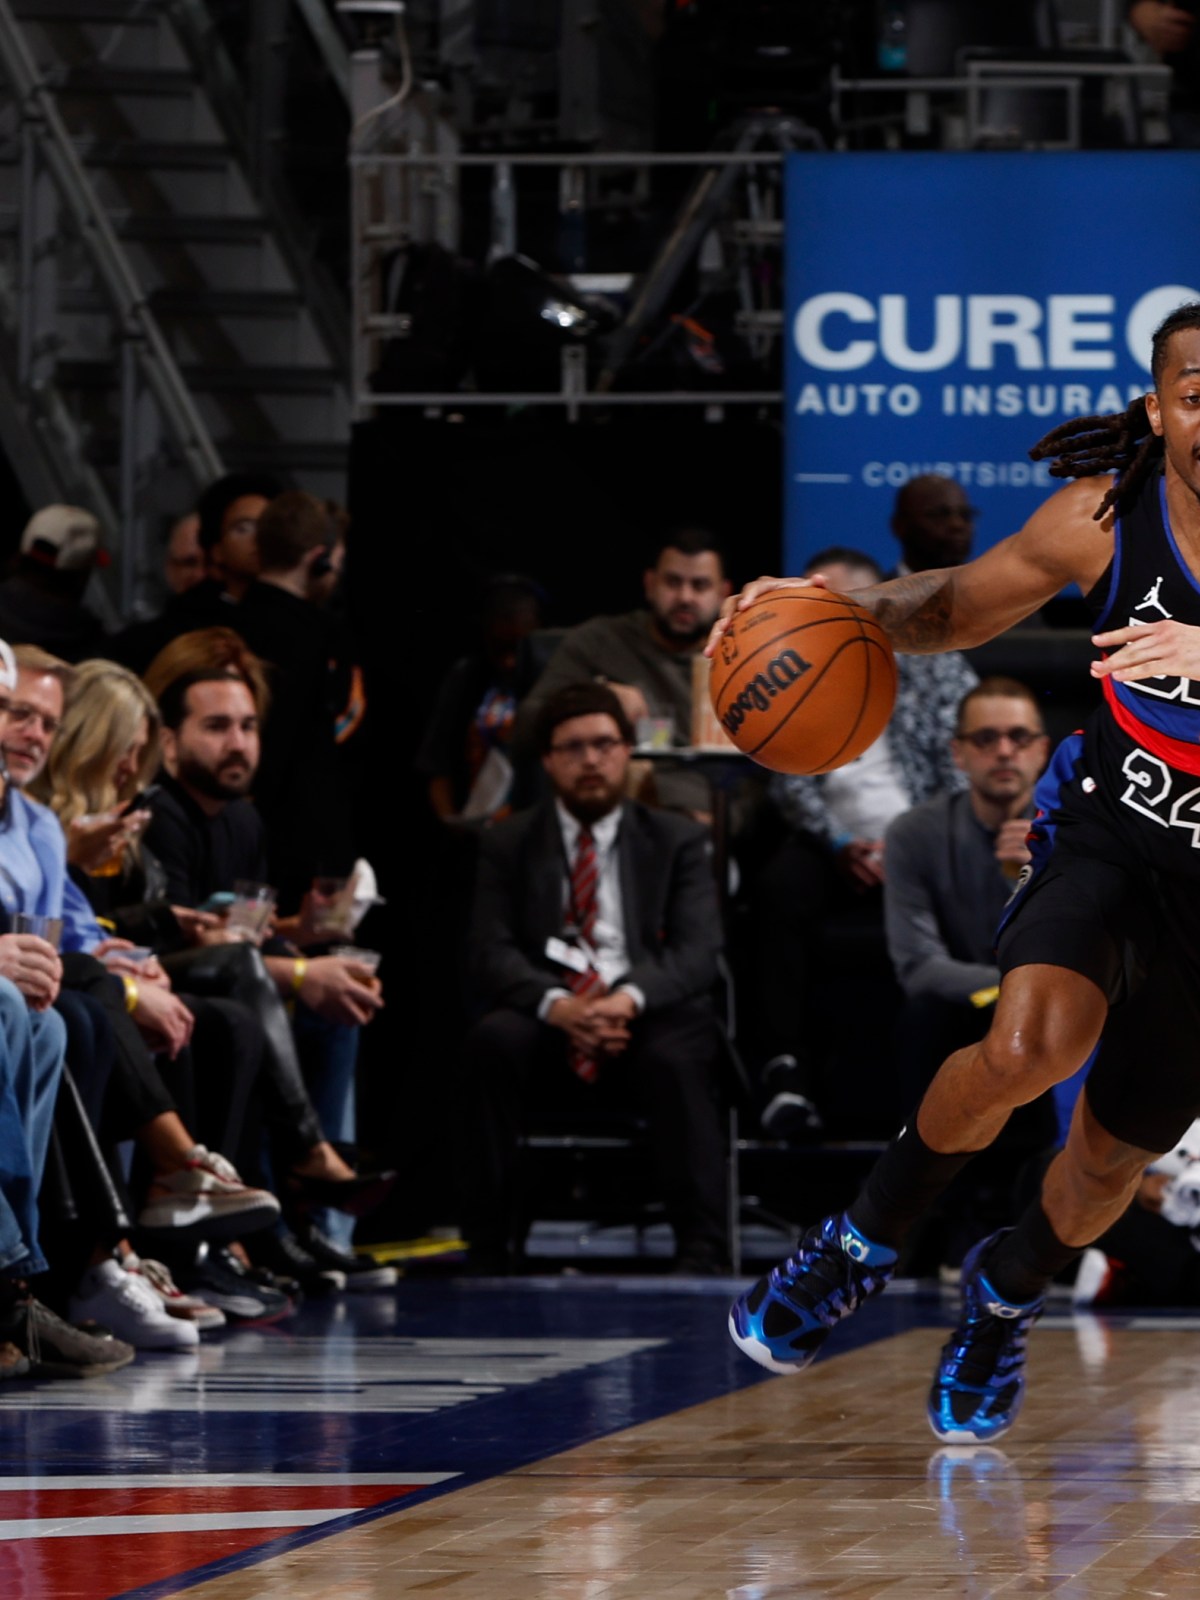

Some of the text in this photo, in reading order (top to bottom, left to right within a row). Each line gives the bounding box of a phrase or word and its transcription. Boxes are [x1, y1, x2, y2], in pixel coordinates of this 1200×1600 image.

[794, 292, 1116, 371] CURE
[795, 384, 920, 415] AUTO
[721, 649, 812, 735] Wilson
